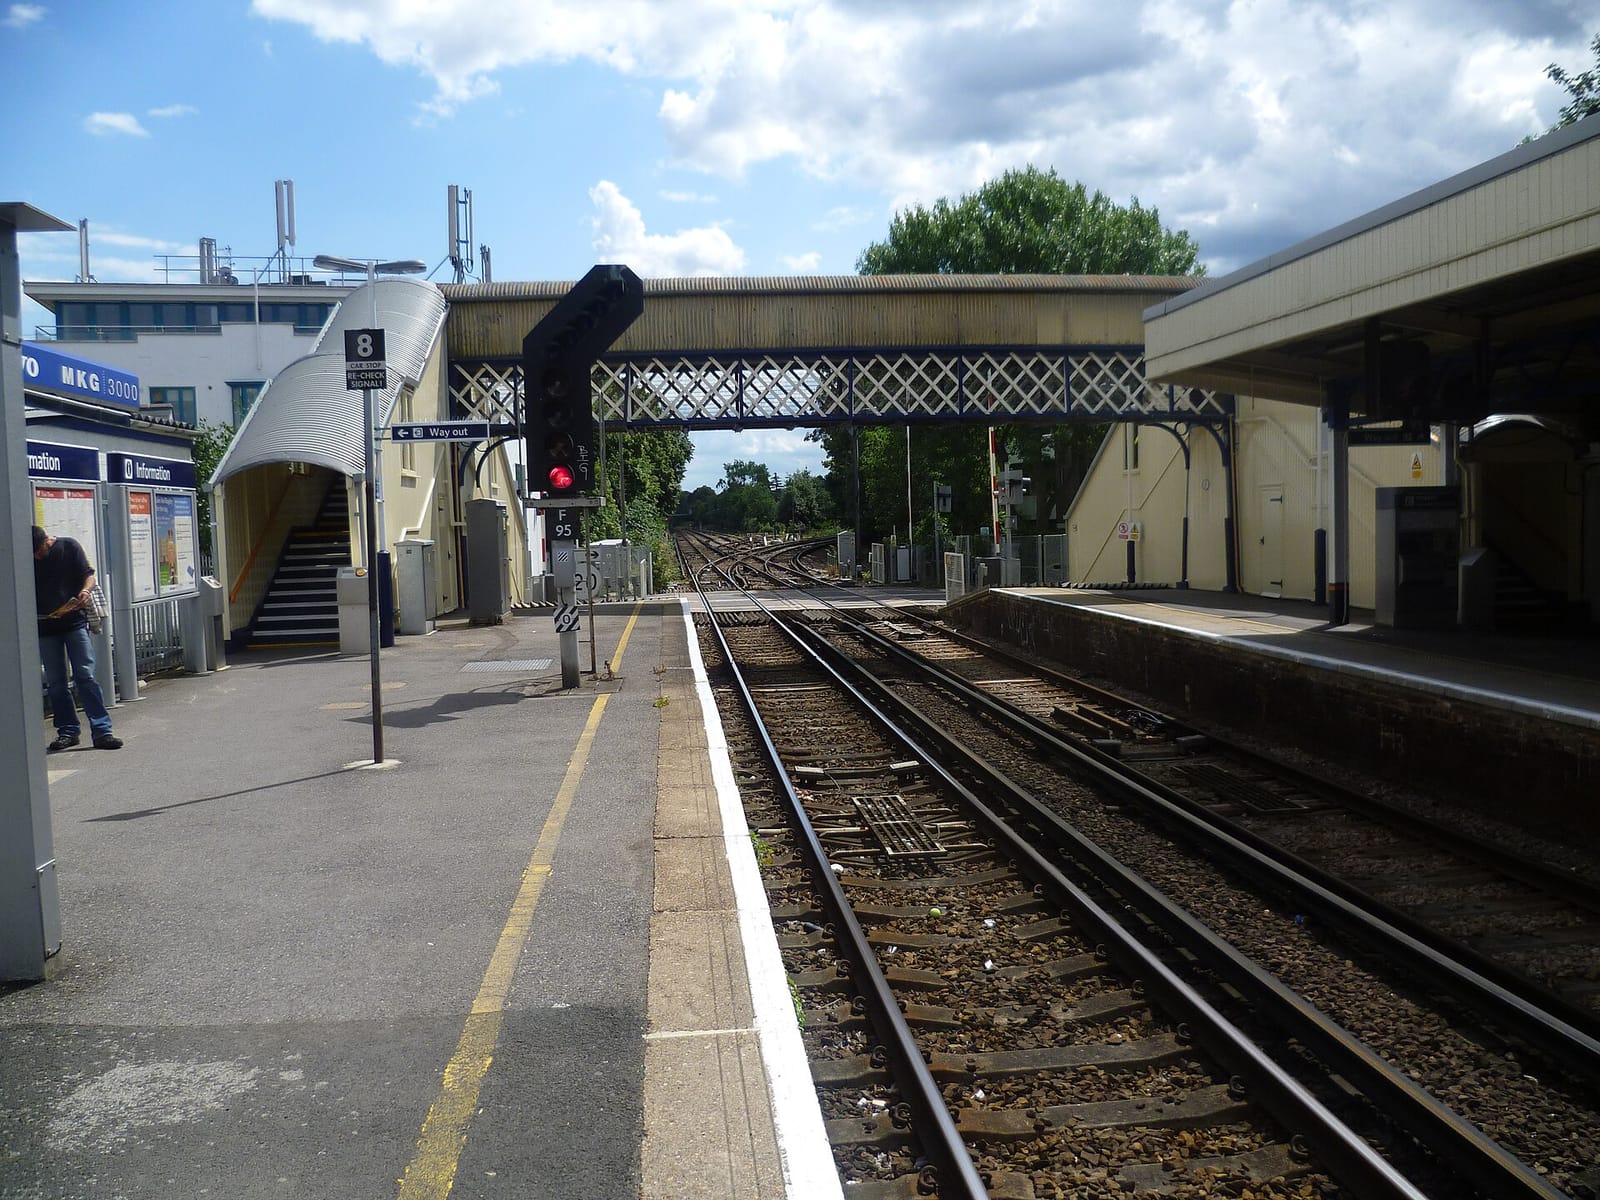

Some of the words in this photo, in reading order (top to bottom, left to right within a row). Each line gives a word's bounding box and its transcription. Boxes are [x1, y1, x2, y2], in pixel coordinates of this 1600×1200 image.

[357, 334, 373, 357] 8
[347, 372, 385, 380] RE-CHECK
[62, 365, 100, 393] MKG
[107, 378, 138, 401] 3000
[429, 427, 450, 438] Way
[452, 427, 468, 436] out
[136, 461, 171, 481] Information
[558, 509, 567, 521] F
[555, 524, 572, 537] 95
